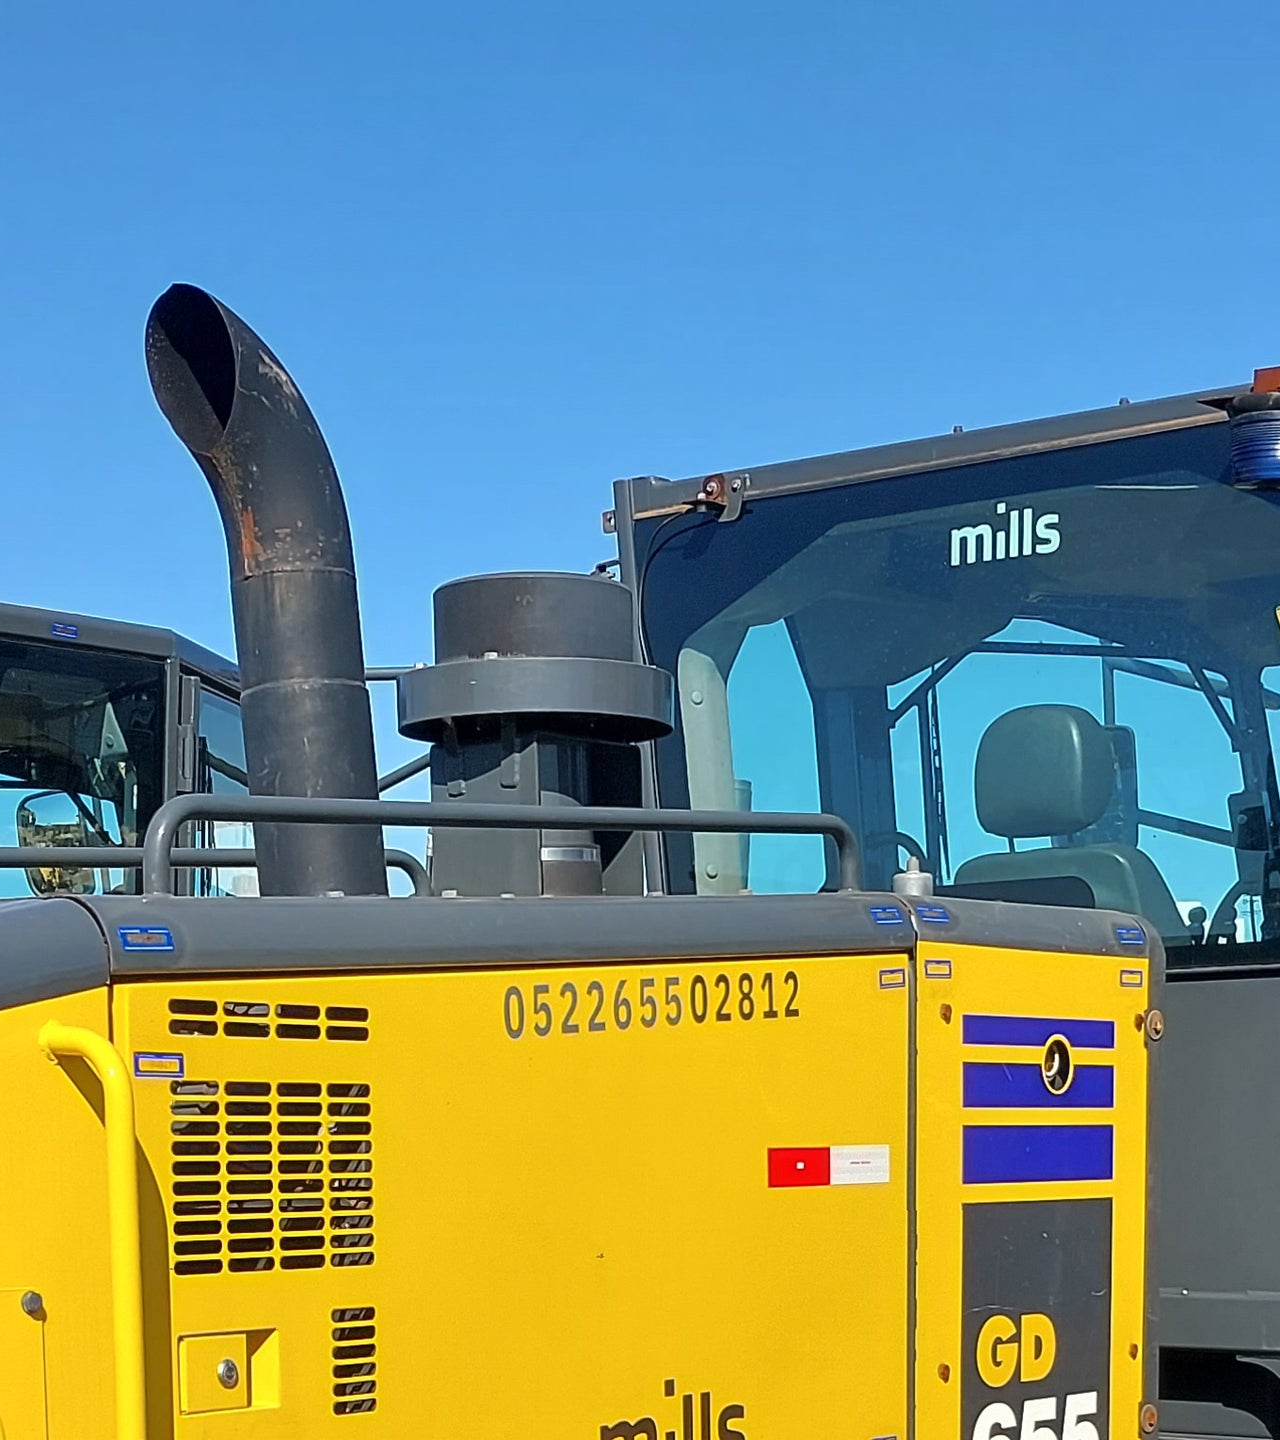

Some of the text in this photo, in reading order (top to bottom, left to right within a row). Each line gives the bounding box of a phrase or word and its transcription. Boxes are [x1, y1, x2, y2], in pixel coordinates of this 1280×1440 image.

[950, 502, 1061, 567] mills
[504, 970, 800, 1039] 052265502812
[977, 1313, 1056, 1388] GD
